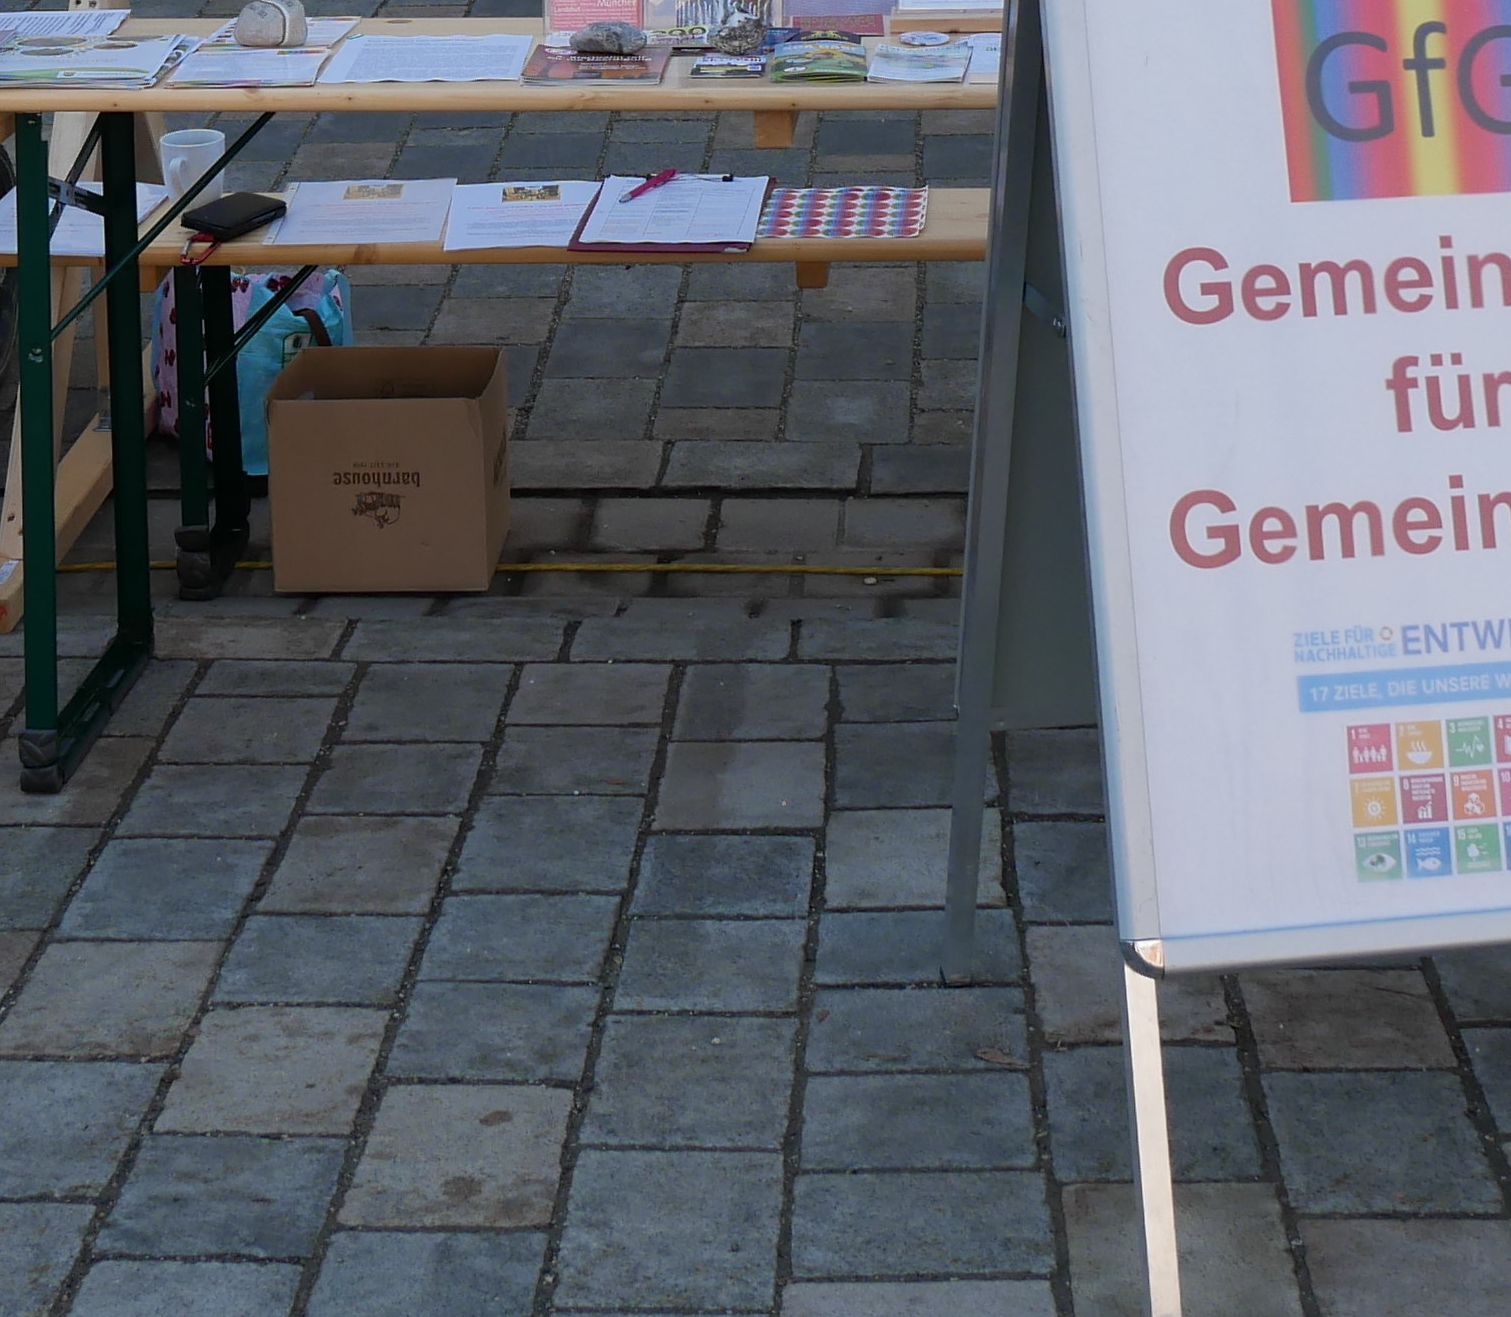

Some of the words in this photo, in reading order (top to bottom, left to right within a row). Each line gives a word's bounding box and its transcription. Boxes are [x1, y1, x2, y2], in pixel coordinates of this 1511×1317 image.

[332, 471, 421, 488] barnhouse
[1293, 629, 1340, 647] ZIELE
[1344, 625, 1374, 643] FÜR
[1294, 642, 1397, 664] NACHHALTIGE
[1309, 687, 1330, 703] 17
[1333, 683, 1383, 702] ZIELE,
[1387, 681, 1418, 698] DIE
[1422, 675, 1490, 695] UNSERE
